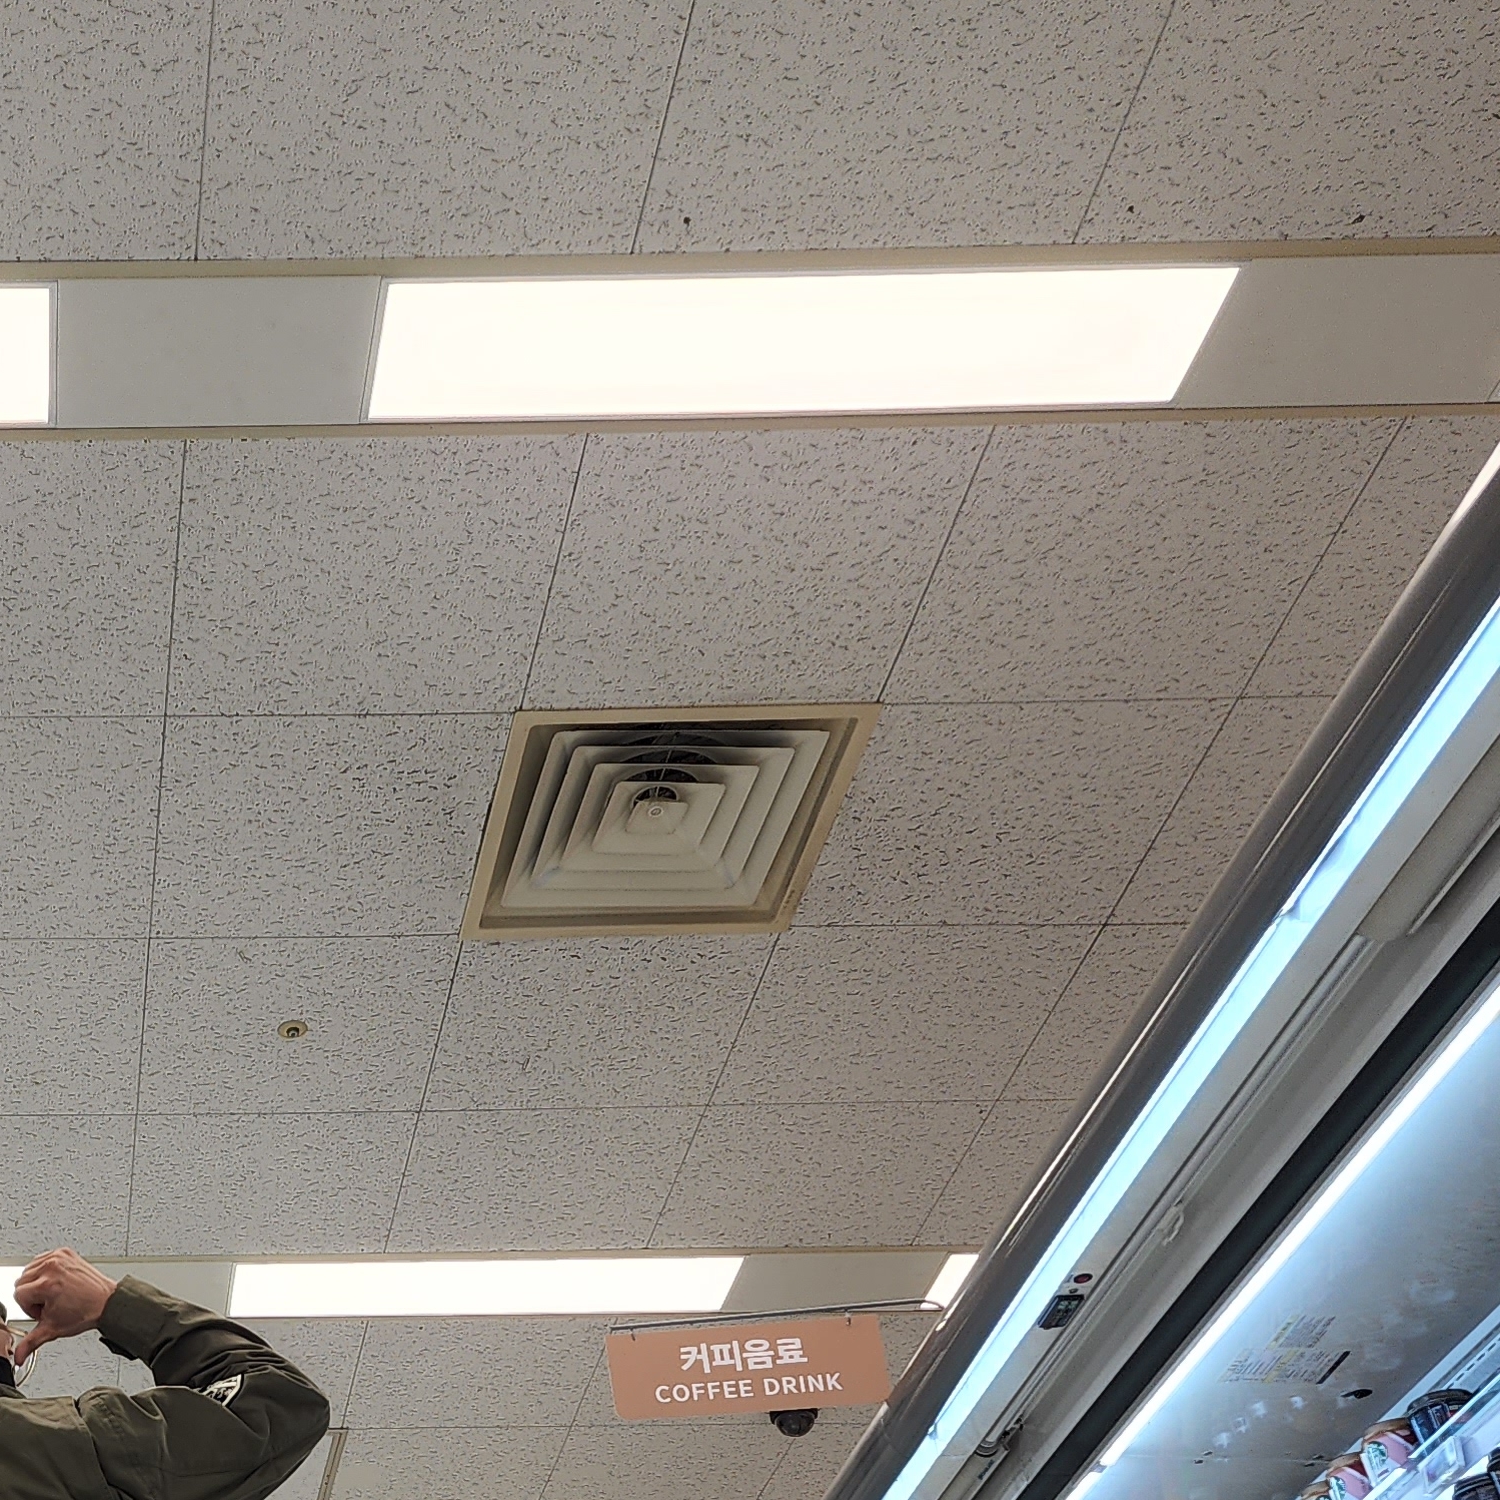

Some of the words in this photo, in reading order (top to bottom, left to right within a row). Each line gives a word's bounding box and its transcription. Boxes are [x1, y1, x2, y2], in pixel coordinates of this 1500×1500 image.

[680, 1337, 808, 1374] 커피음료
[654, 1379, 754, 1404] COFFEE
[763, 1371, 844, 1397] DRINK
